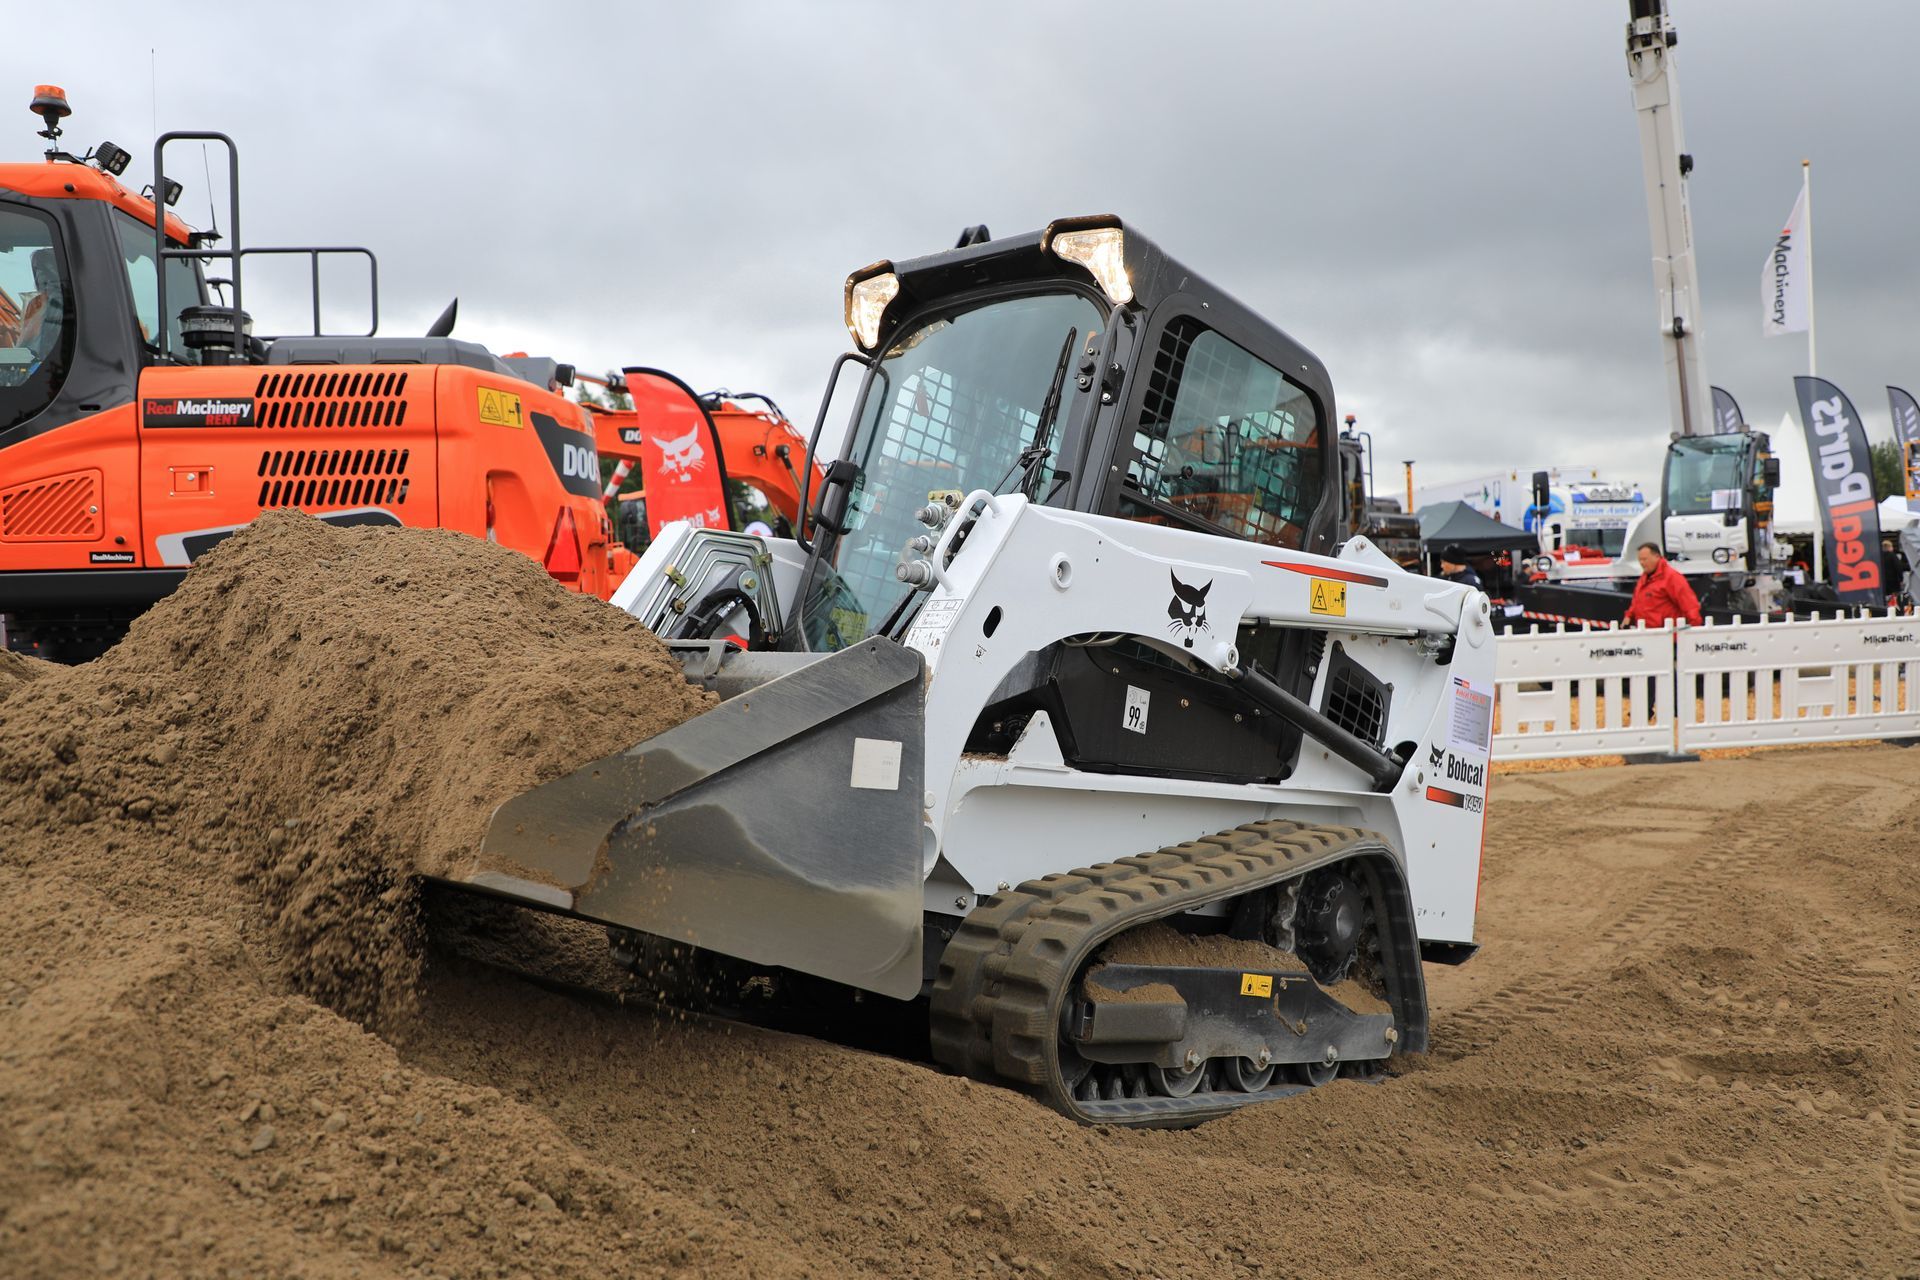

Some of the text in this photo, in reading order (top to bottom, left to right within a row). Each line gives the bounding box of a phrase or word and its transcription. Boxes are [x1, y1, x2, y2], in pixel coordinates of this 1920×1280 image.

[146, 400, 252, 418] RealMachinery
[205, 415, 240, 425] RENT
[1129, 705, 1141, 728] 99
[1446, 753, 1484, 787] Bobcat
